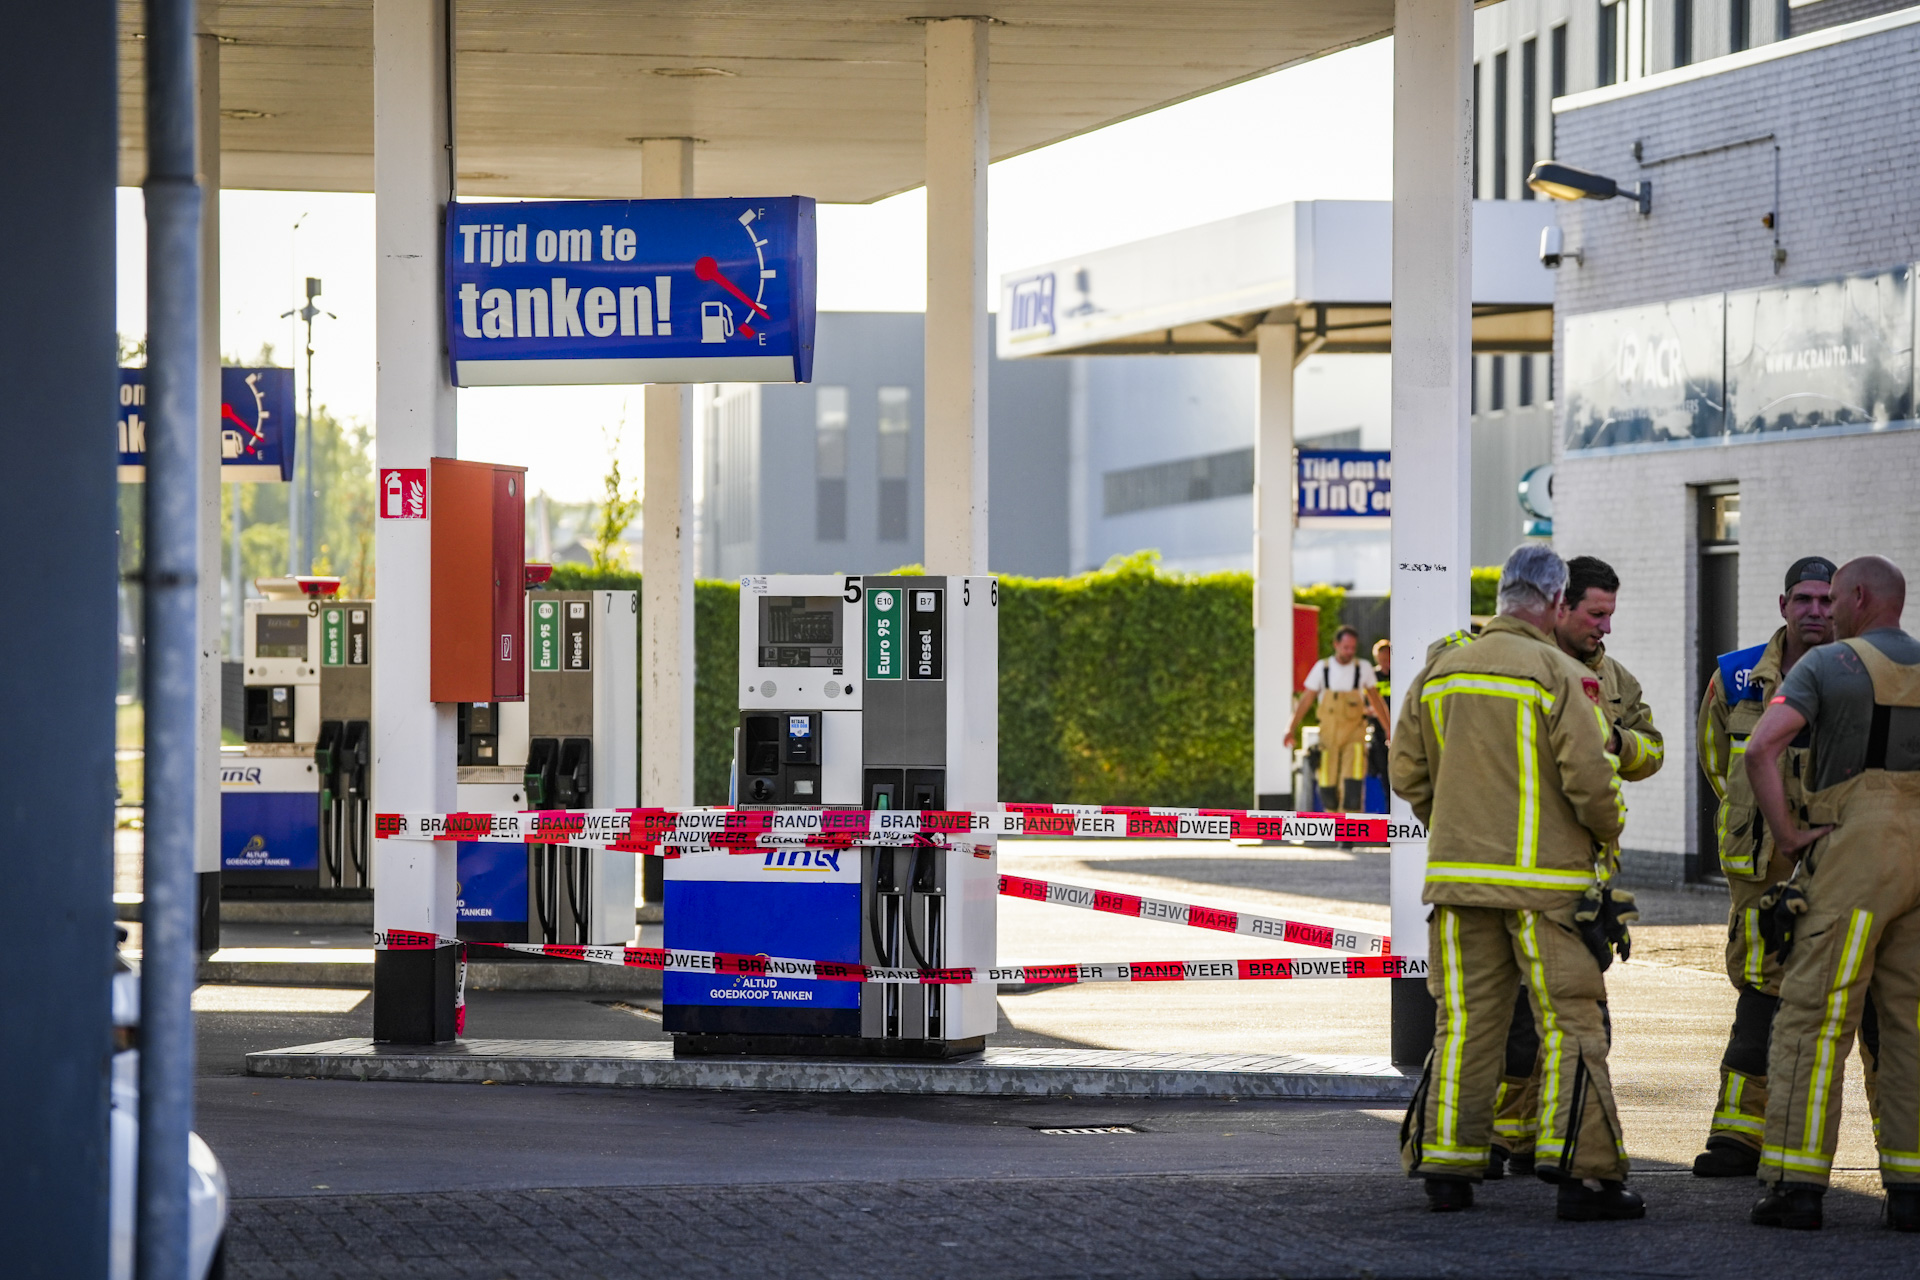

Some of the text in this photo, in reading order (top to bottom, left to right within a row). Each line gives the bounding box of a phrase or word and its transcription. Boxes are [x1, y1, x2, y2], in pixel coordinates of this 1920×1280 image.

[758, 208, 765, 220] F
[459, 224, 636, 267] Tijd om te
[458, 275, 672, 338] tanken!
[758, 333, 766, 346] E
[1301, 458, 1340, 480] Tijd
[1342, 461, 1375, 480] om
[843, 576, 862, 604] 5
[963, 579, 970, 607] 5
[991, 580, 997, 607] 6
[308, 601, 319, 617] 9
[540, 606, 552, 614] E10
[573, 606, 582, 614] B7
[606, 593, 612, 614] 7
[631, 593, 637, 614] 8
[877, 597, 892, 606] E10
[920, 597, 932, 606] B7
[540, 624, 551, 668] Euro 95
[572, 631, 583, 667] Diesel
[877, 618, 890, 675] Euro 95
[919, 629, 931, 675] Diesel
[421, 816, 518, 831] BRANDWEER
[531, 816, 631, 830] BRANDWEER
[644, 815, 747, 828] BRANDWEER
[762, 815, 866, 828] BRANDWEER
[881, 815, 990, 829] BRANDWEER
[1004, 817, 1115, 832] BRANDWEER
[1129, 819, 1240, 834] BRANDWEER
[1257, 822, 1370, 837] BRANDWEER
[460, 908, 492, 916] TANKEN
[623, 951, 723, 970] BRANDWEER
[737, 958, 848, 977] BRANDWEER
[862, 968, 974, 981] BRANDWEER
[989, 966, 1102, 980] BRANDWEER
[1118, 963, 1233, 978] BRANDWEER
[1250, 960, 1365, 976] BRANDWEER
[742, 978, 777, 988] ALTIJD
[709, 989, 812, 1000] GOEDKOOP TANKEN
